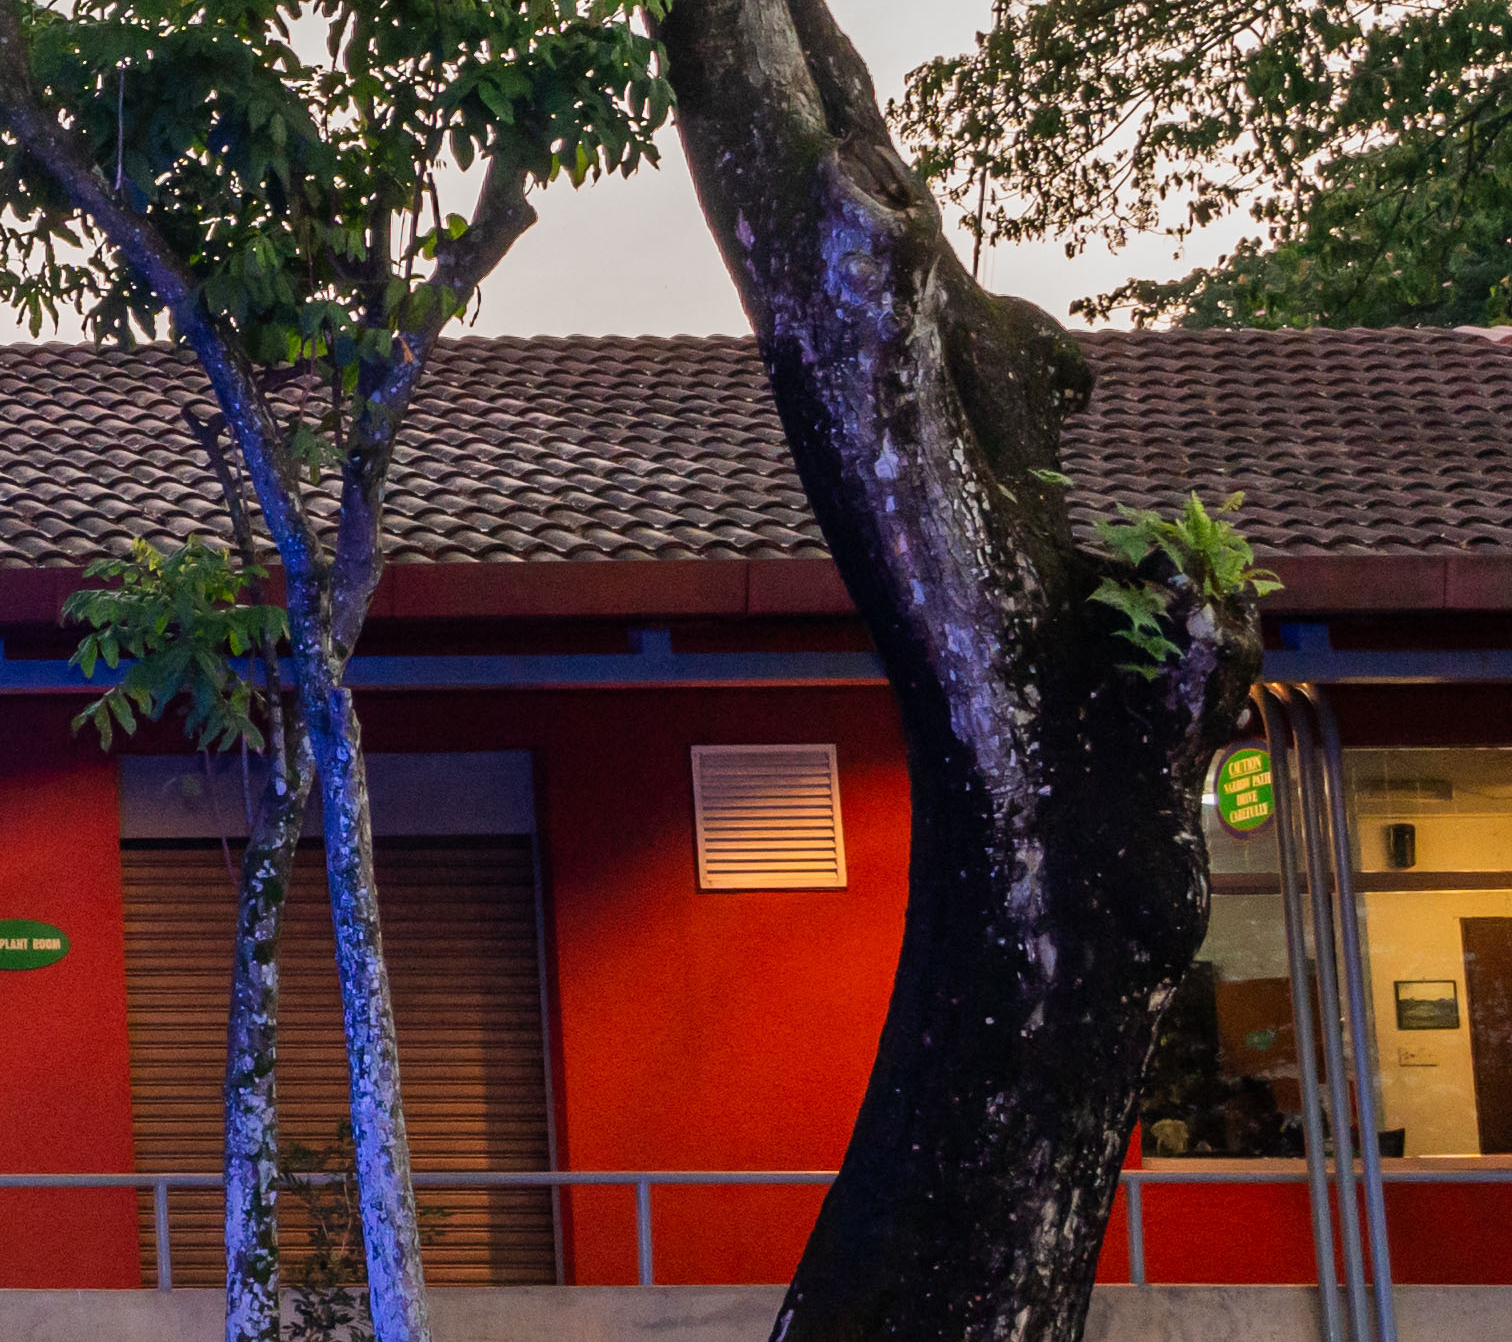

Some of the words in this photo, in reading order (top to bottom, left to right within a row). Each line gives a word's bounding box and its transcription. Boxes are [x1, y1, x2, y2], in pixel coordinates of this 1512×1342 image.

[1228, 755, 1262, 777] CAUTION
[0, 938, 28, 950] PLANT
[32, 938, 61, 950] ROOM
